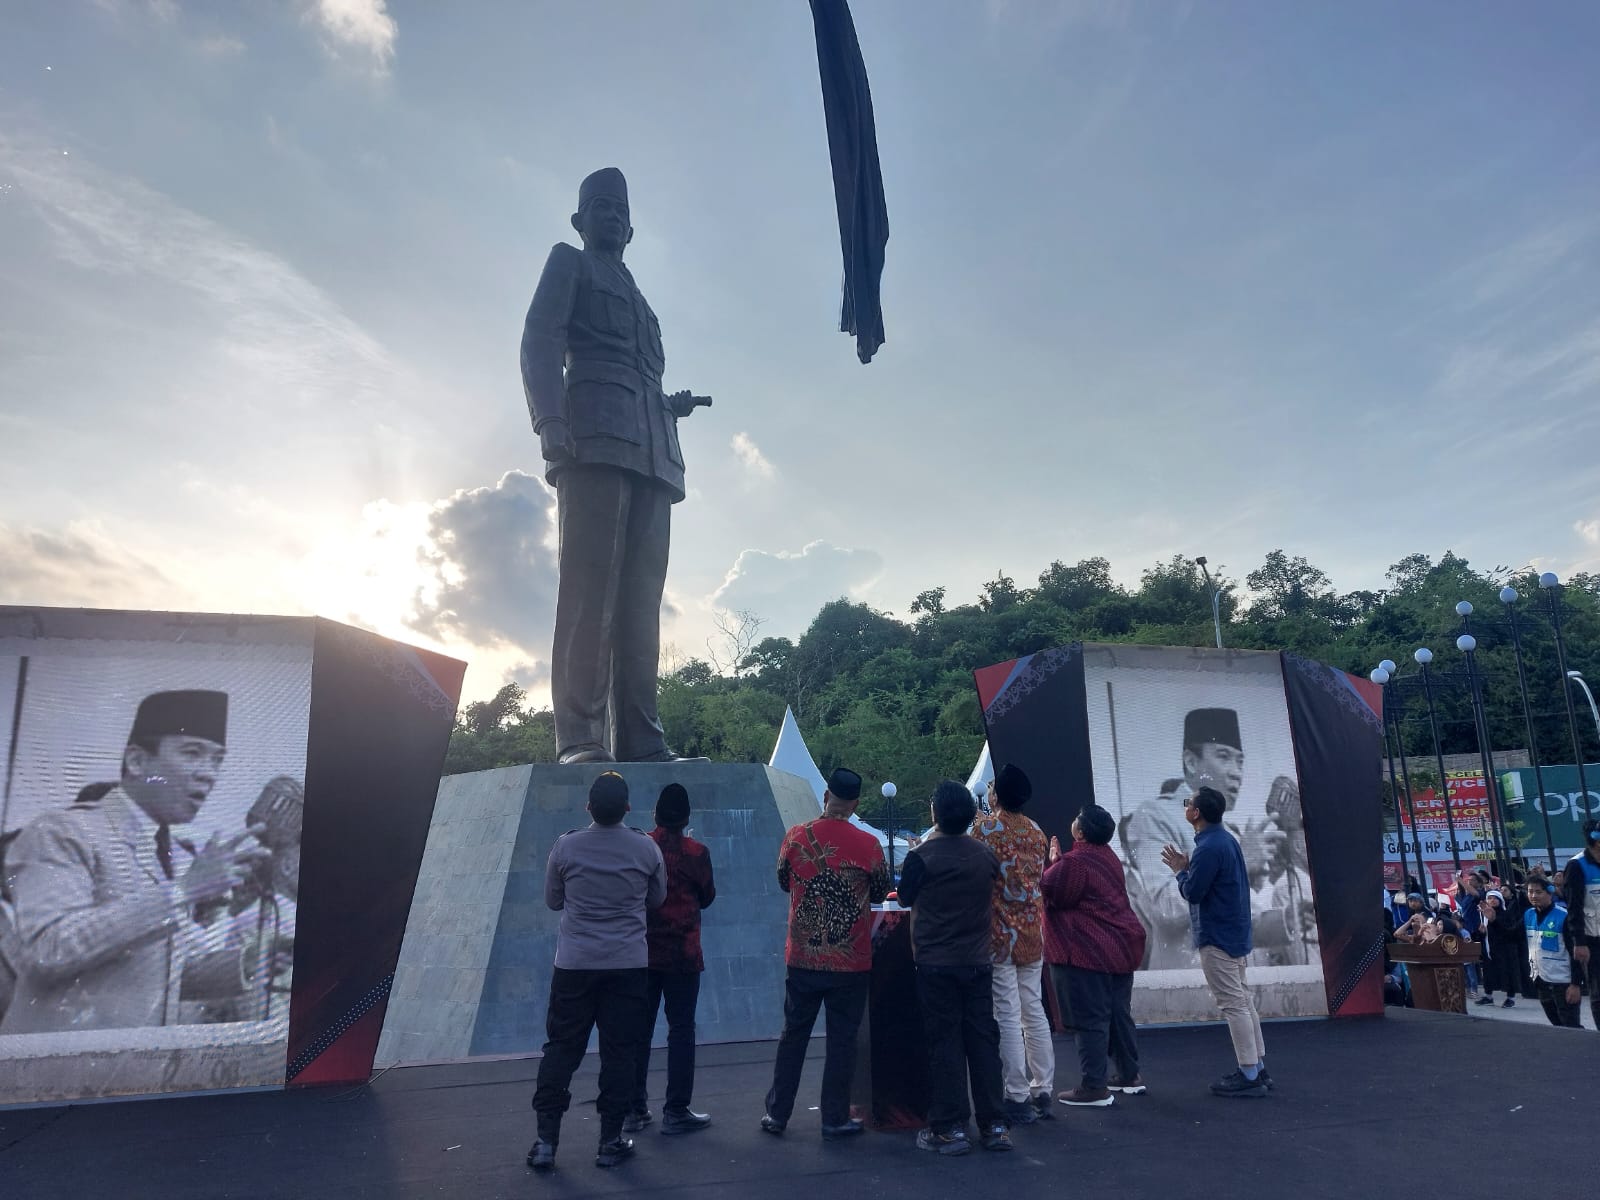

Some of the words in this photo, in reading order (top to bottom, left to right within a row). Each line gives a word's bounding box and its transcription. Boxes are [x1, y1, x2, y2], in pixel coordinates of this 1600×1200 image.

[1415, 797, 1489, 808] ERVICE
[1425, 841, 1441, 854] HP
[1458, 839, 1494, 852] LAPTO
